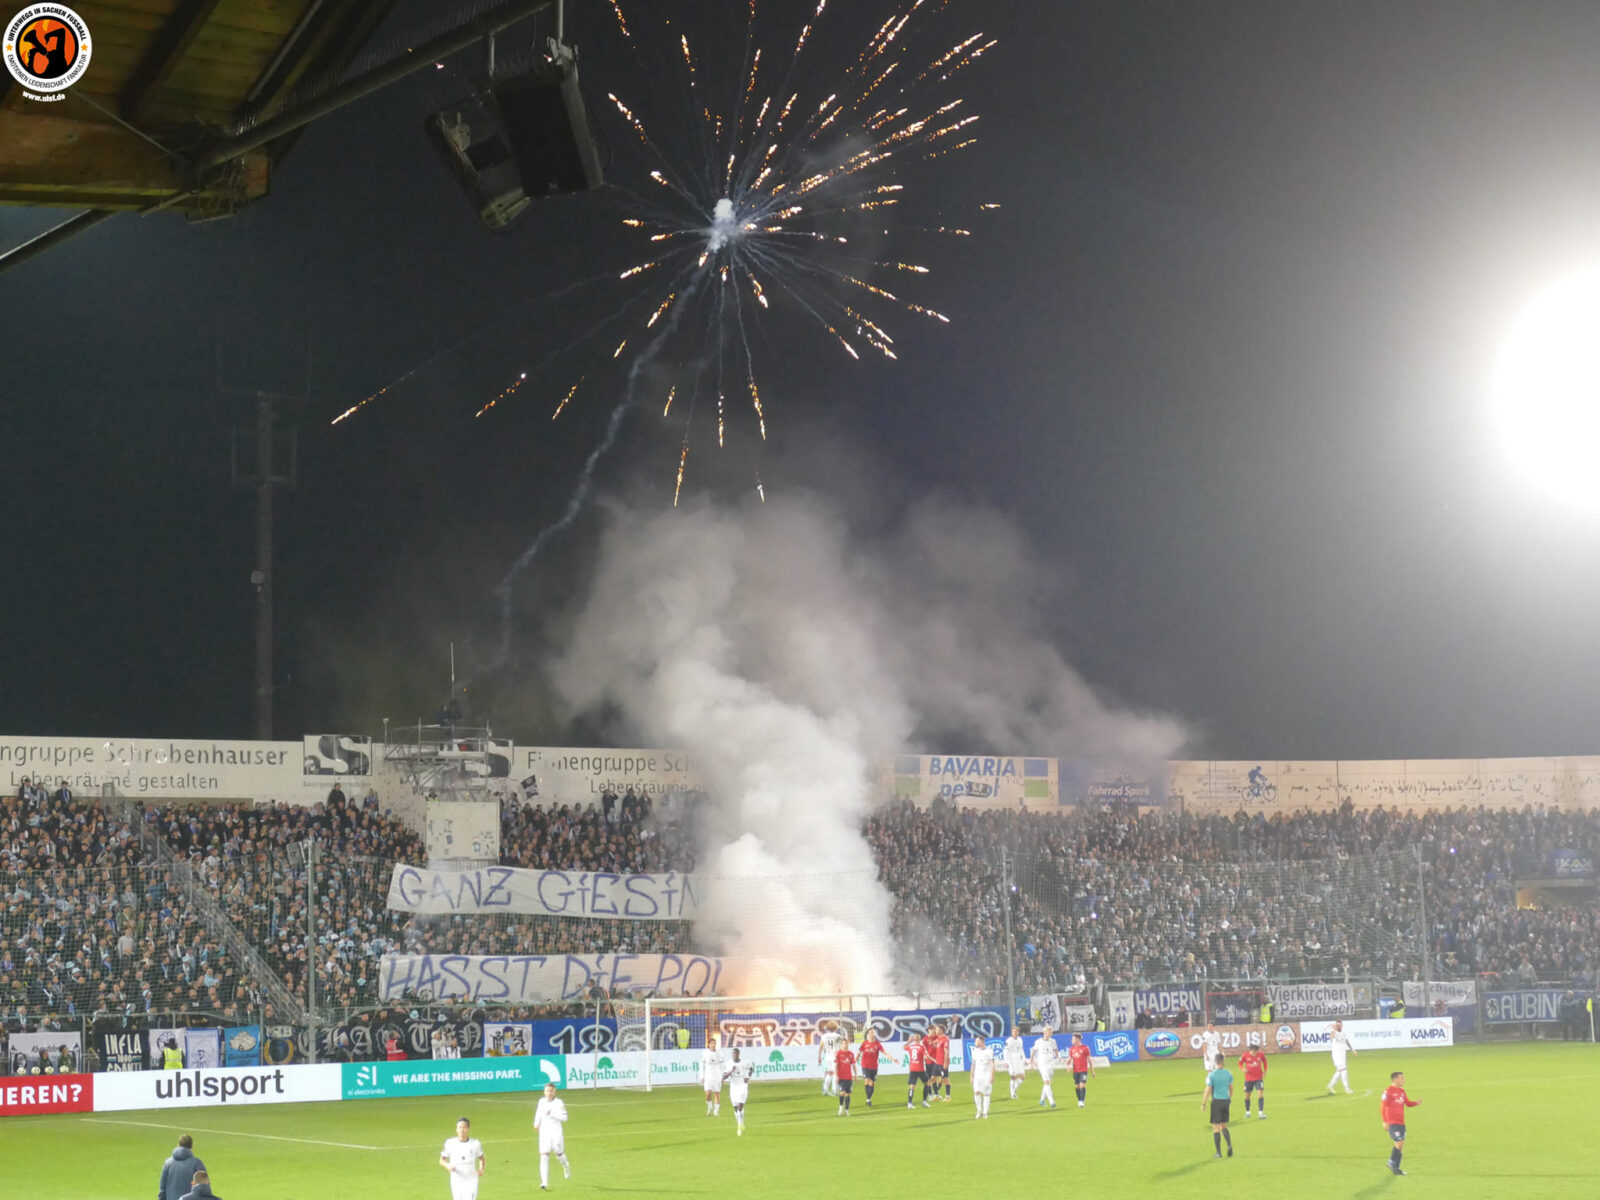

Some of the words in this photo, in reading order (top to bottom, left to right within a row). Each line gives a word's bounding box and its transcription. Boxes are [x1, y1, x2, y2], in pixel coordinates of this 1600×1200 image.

[527, 751, 656, 775] Fmengruppe
[930, 757, 1016, 777] BAVARIA
[139, 773, 219, 792] gestalten
[1088, 784, 1122, 797] Fahrrad
[398, 868, 514, 909] GANZ
[387, 955, 547, 1000] HASST
[1135, 990, 1201, 1013] HADERN
[1268, 985, 1348, 1002] Vierkirchen
[1190, 1031, 1241, 1050] OZD
[1302, 1032, 1333, 1044] KAMP
[1353, 1030, 1402, 1039] www.kampa.de
[1410, 1028, 1446, 1040] KAMPA
[105, 1033, 142, 1055] INFLA
[1096, 1036, 1127, 1051] Bayern
[1113, 1042, 1133, 1056] Park
[912, 1048, 918, 1060] 8
[393, 1074, 408, 1084] WE
[410, 1073, 430, 1083] ARE
[431, 1072, 451, 1082] THE
[452, 1070, 493, 1081] MISSING
[495, 1069, 522, 1079] PART.
[568, 1066, 638, 1084] Alpenbauer
[752, 1059, 807, 1077] lpenbauer
[155, 1069, 285, 1102] uhlsport
